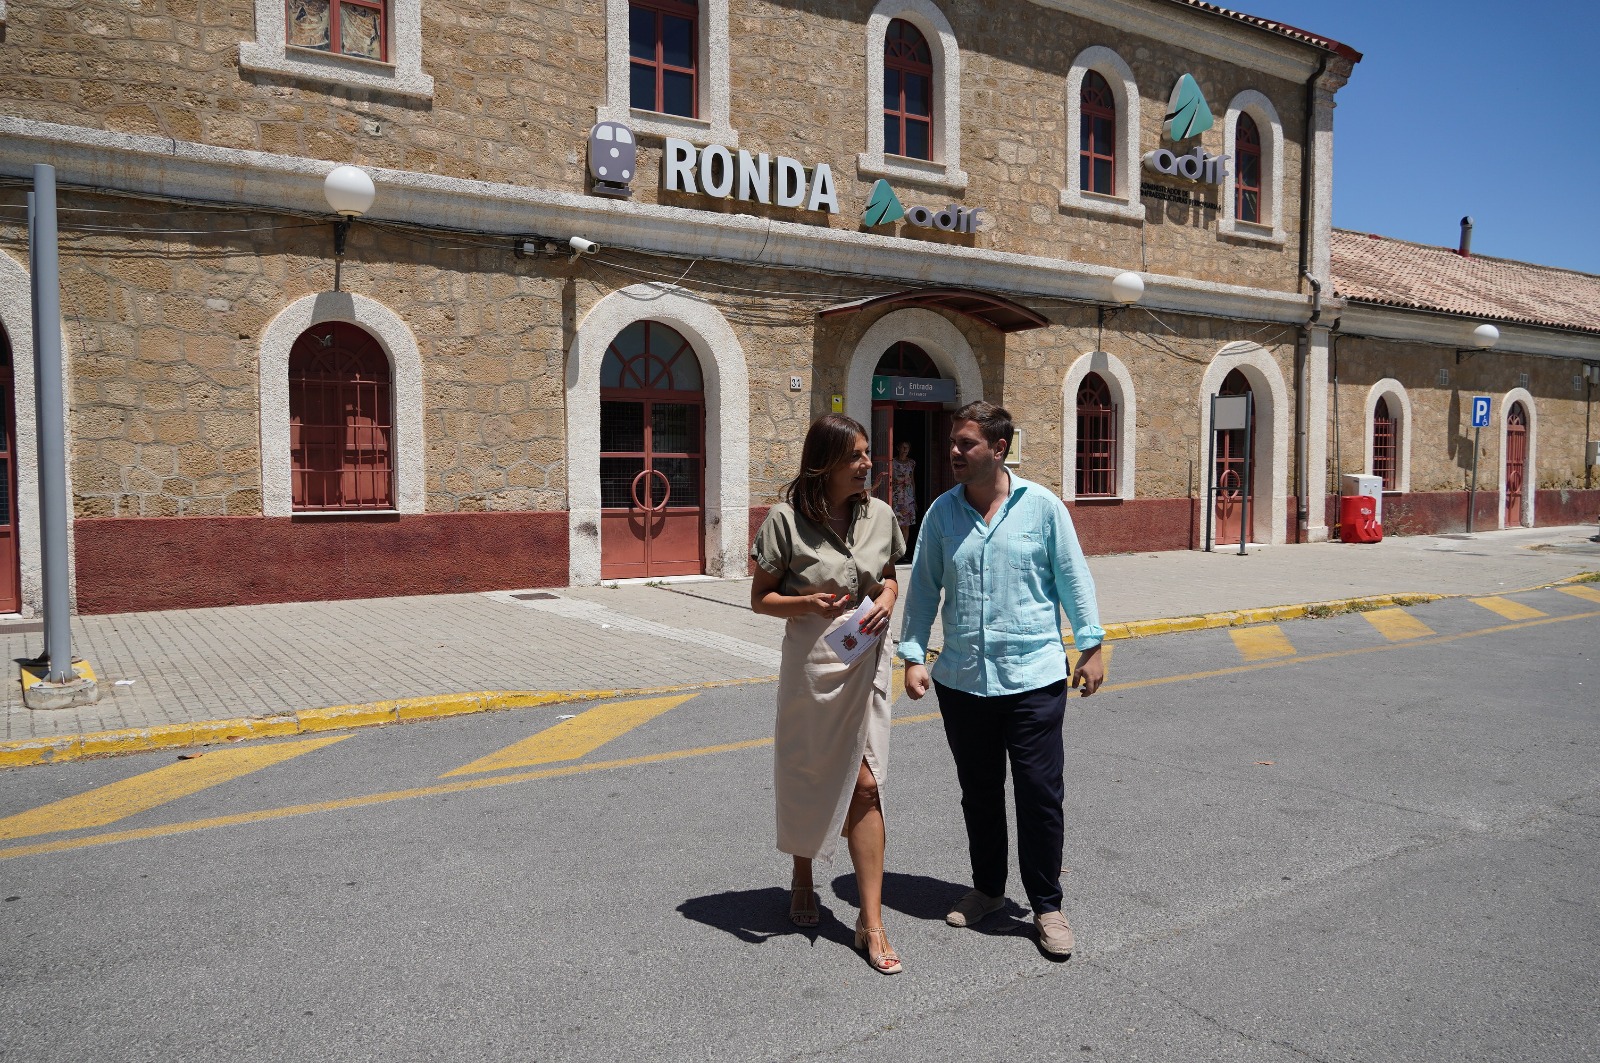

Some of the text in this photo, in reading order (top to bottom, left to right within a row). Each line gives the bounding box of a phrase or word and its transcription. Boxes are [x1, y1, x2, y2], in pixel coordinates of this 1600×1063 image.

[664, 137, 839, 214] RONDA
[1144, 146, 1231, 185] adif
[905, 203, 984, 233] adif
[909, 382, 933, 391] Entrada
[1475, 400, 1488, 424] P
